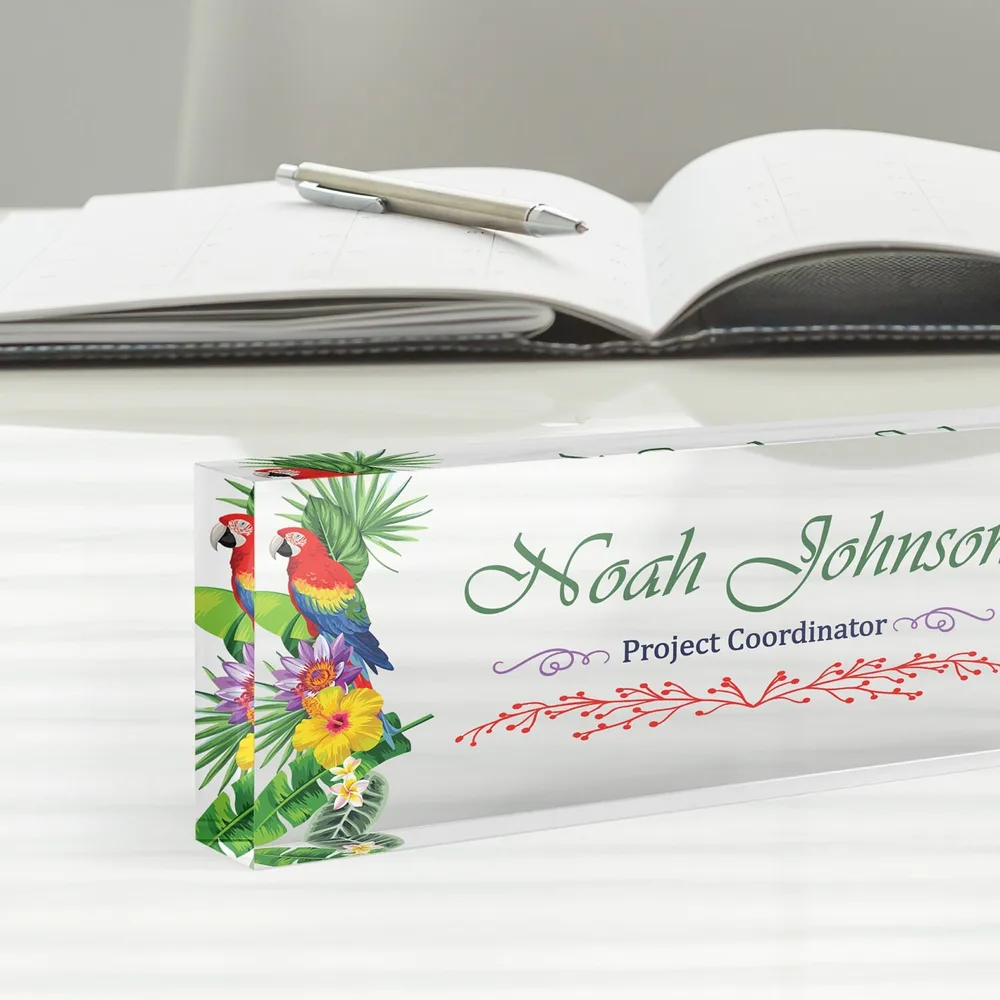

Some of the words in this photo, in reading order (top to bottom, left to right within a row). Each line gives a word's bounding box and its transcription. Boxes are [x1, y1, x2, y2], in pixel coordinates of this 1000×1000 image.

[464, 526, 707, 615] Noah
[622, 634, 721, 665] Project
[727, 617, 888, 651] Coordinator
